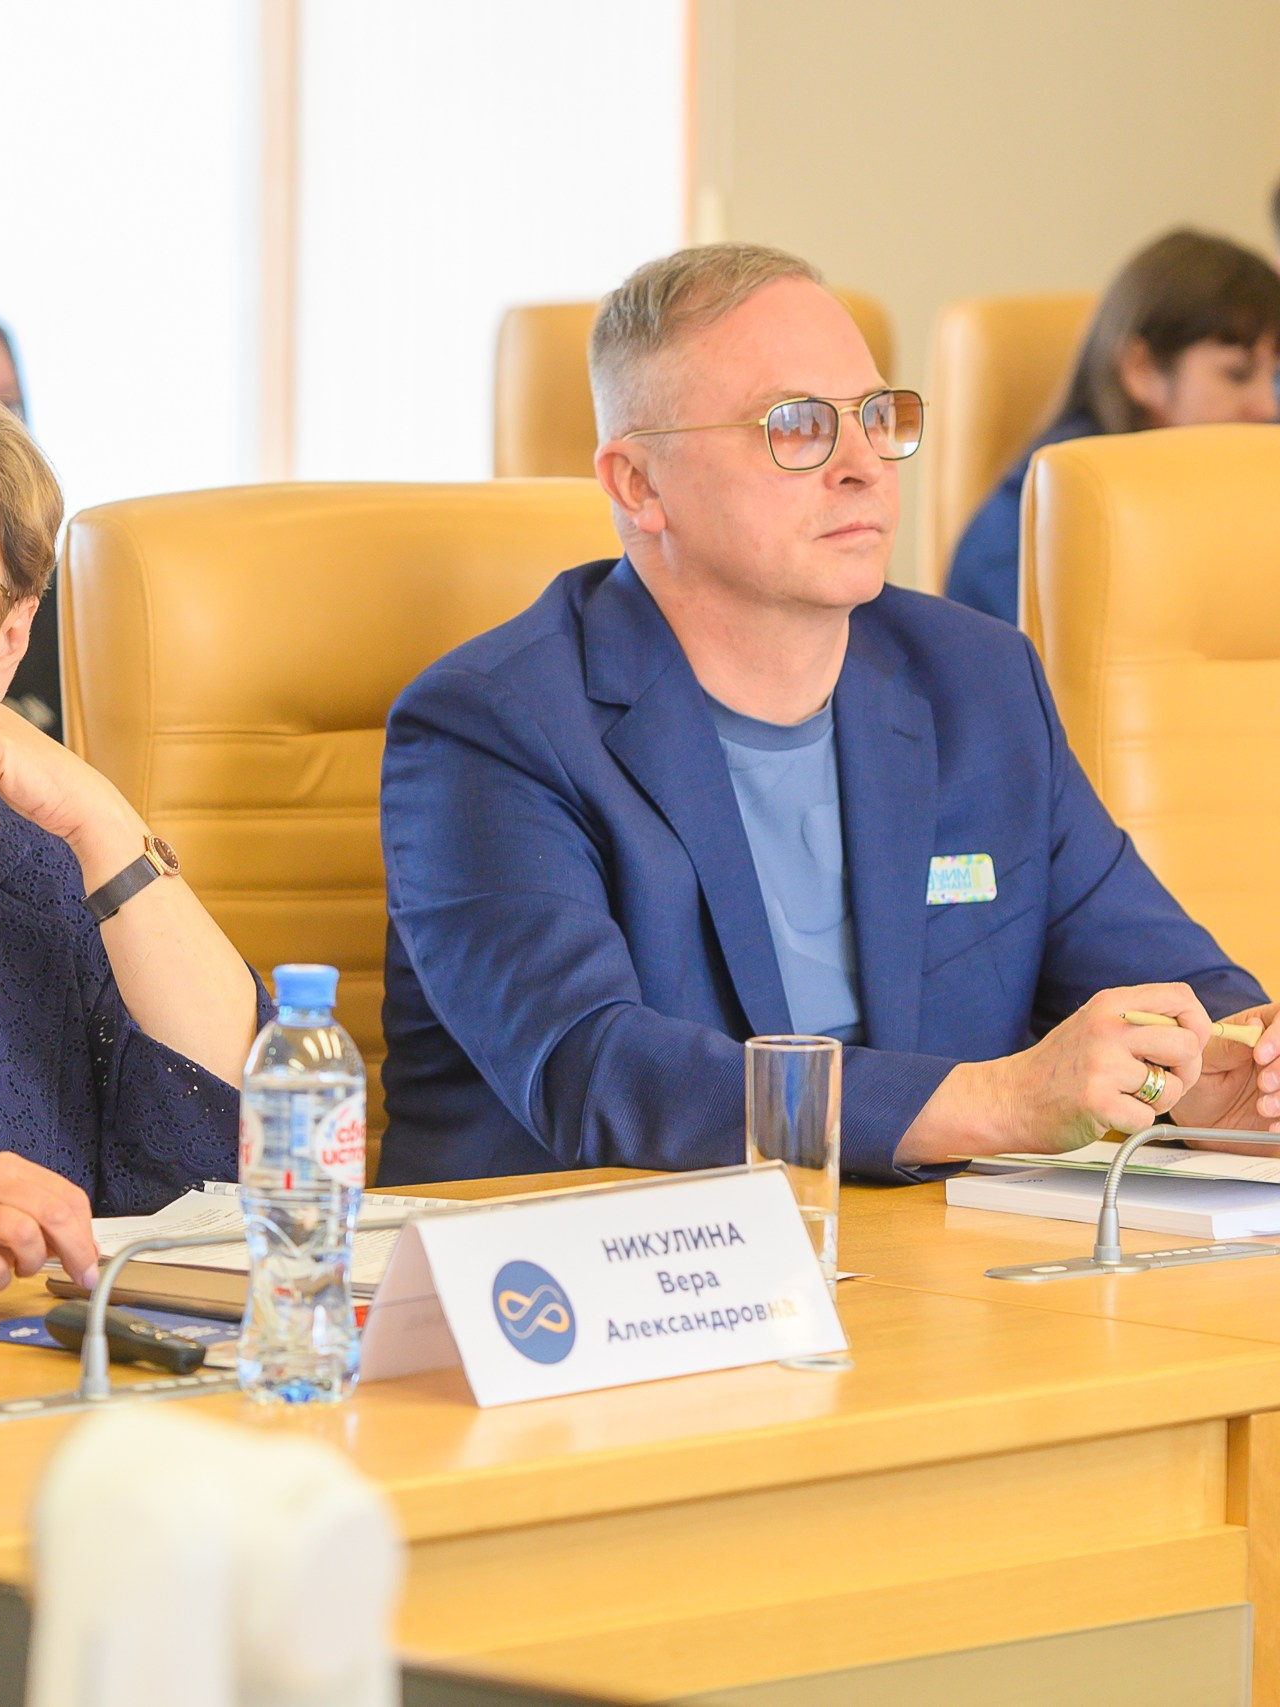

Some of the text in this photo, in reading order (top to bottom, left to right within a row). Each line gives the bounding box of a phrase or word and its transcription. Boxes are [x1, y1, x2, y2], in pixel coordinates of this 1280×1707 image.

[602, 1222, 745, 1262] НИКУЛИНА
[657, 1271, 720, 1296] Вера
[607, 1298, 798, 1342] Александровна
